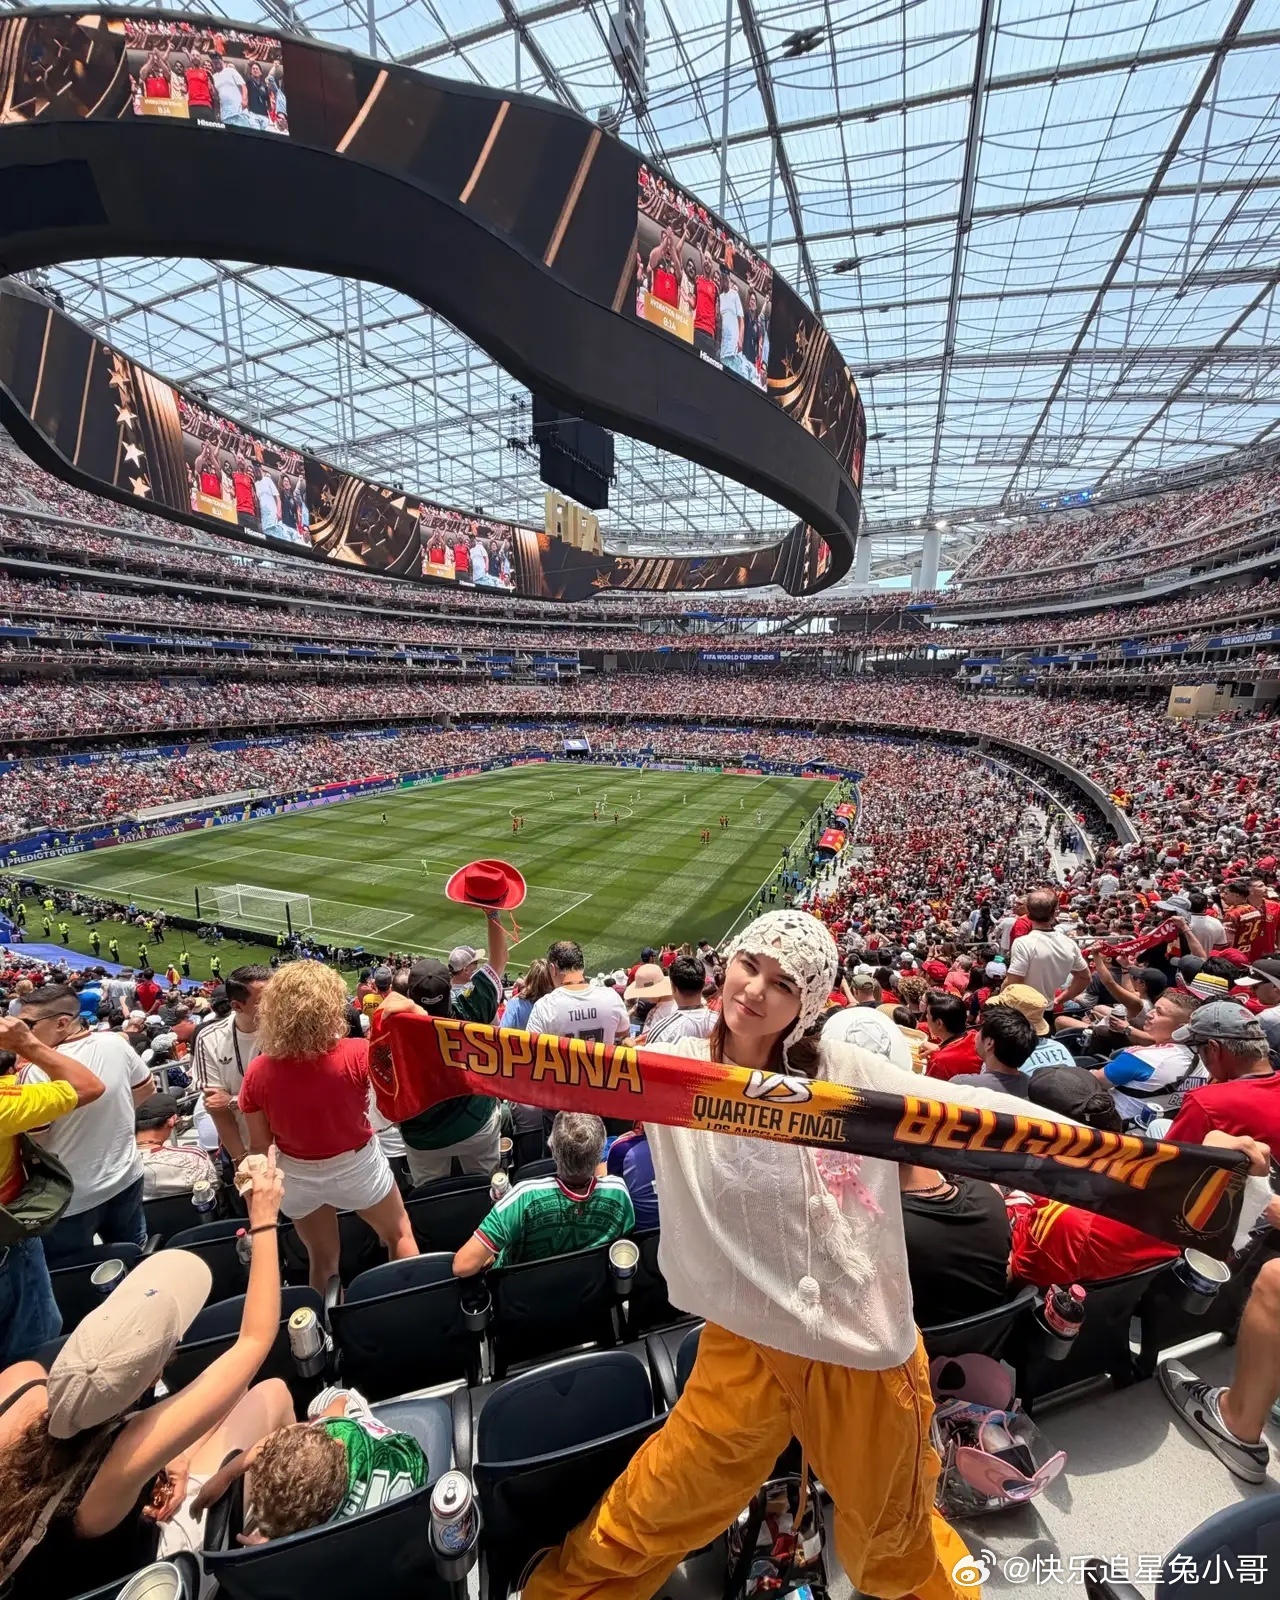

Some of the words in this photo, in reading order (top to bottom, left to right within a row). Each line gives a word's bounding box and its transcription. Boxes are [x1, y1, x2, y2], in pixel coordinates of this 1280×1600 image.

[197, 118, 226, 129] Hisense
[544, 490, 604, 557] FIFA
[175, 639, 213, 647] ANGELES
[1255, 631, 1272, 641] 2026
[1137, 648, 1148, 656] LOS
[412, 776, 433, 786] aramco
[219, 814, 238, 824] VISA
[117, 832, 148, 844] QATAR
[151, 824, 185, 837] AIRWAYS
[7, 844, 85, 865] PREDICTSTREET
[568, 1007, 597, 1022] TULIO
[743, 1070, 814, 1103] VS
[693, 1094, 784, 1132] QUARTER
[788, 1110, 847, 1143] FINAL
[893, 1095, 1181, 1190] BELGIUM
